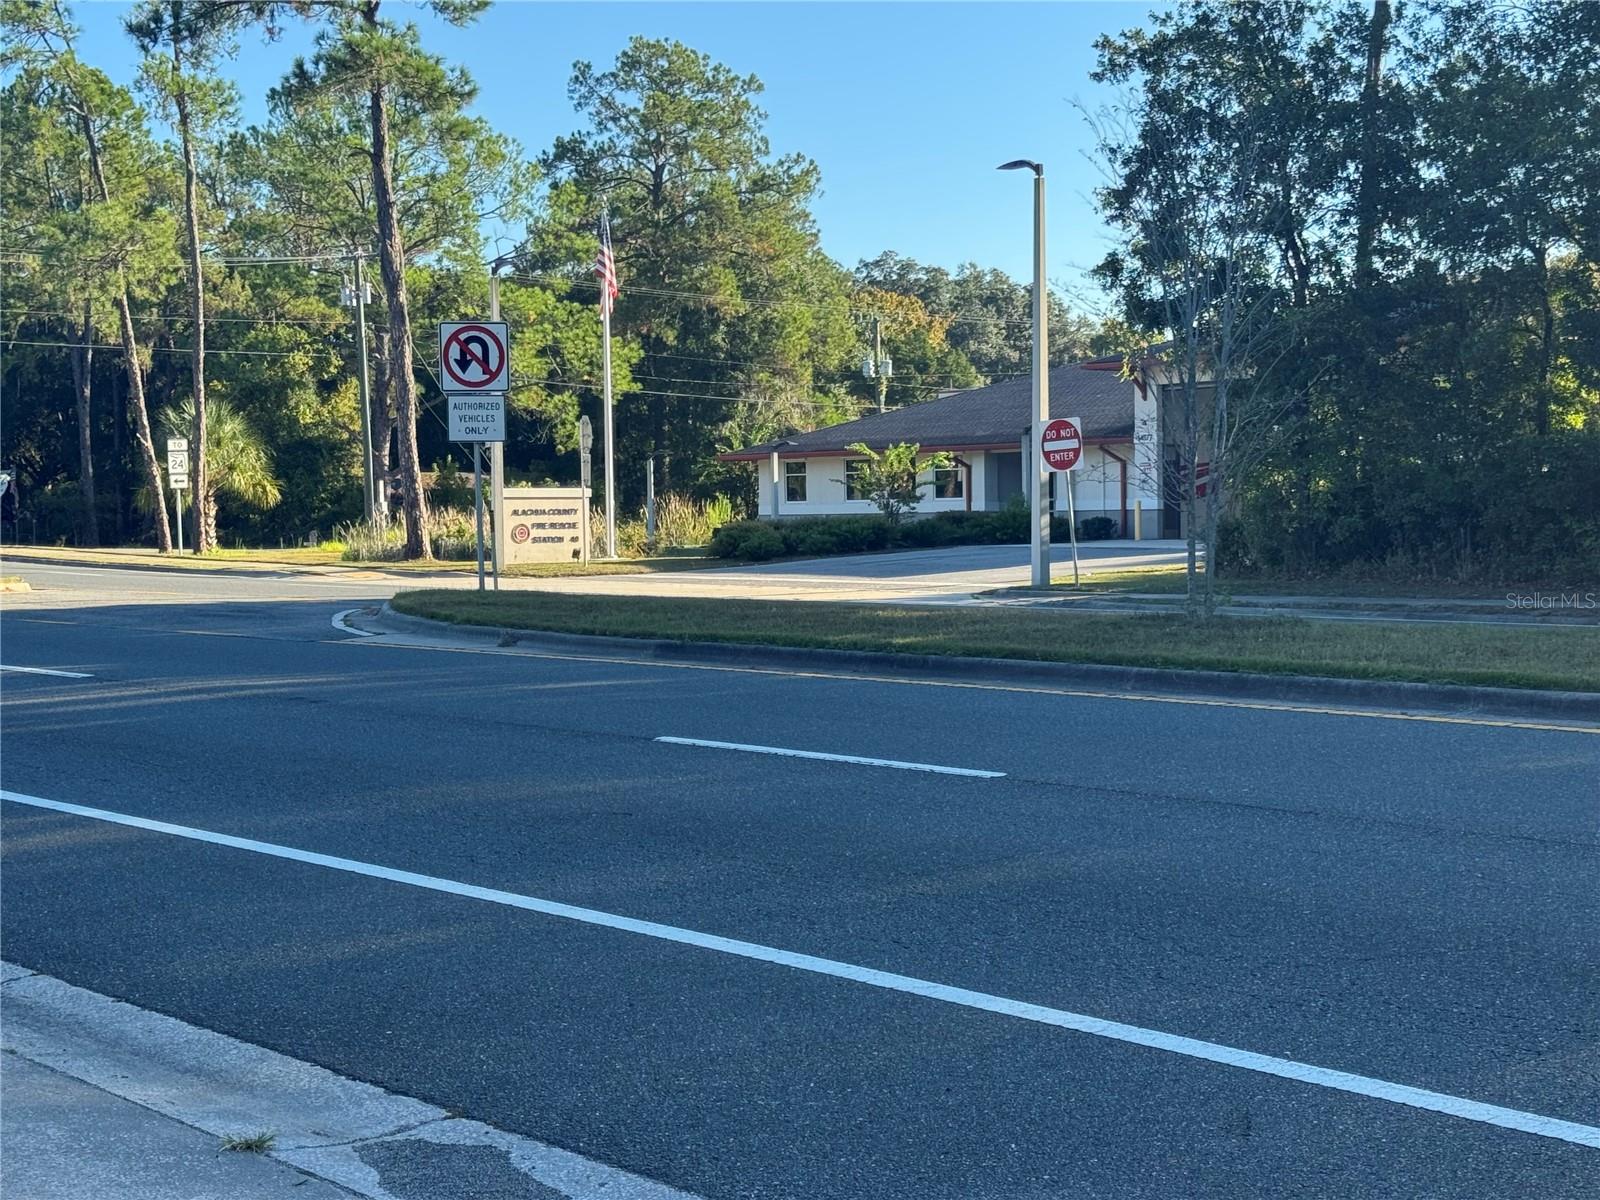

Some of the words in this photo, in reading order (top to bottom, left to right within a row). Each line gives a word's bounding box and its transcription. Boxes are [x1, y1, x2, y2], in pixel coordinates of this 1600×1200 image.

[453, 402, 501, 411] AUTHORIZED
[458, 414, 496, 423] VEHICLES
[464, 426, 489, 435] ONLY
[1045, 430, 1057, 440] DO
[1060, 427, 1075, 437] NOT
[172, 441, 183, 449] TO
[1050, 451, 1075, 462] ENTER
[171, 459, 184, 470] 24
[547, 508, 578, 516] COUNTY
[531, 536, 565, 544] STATION
